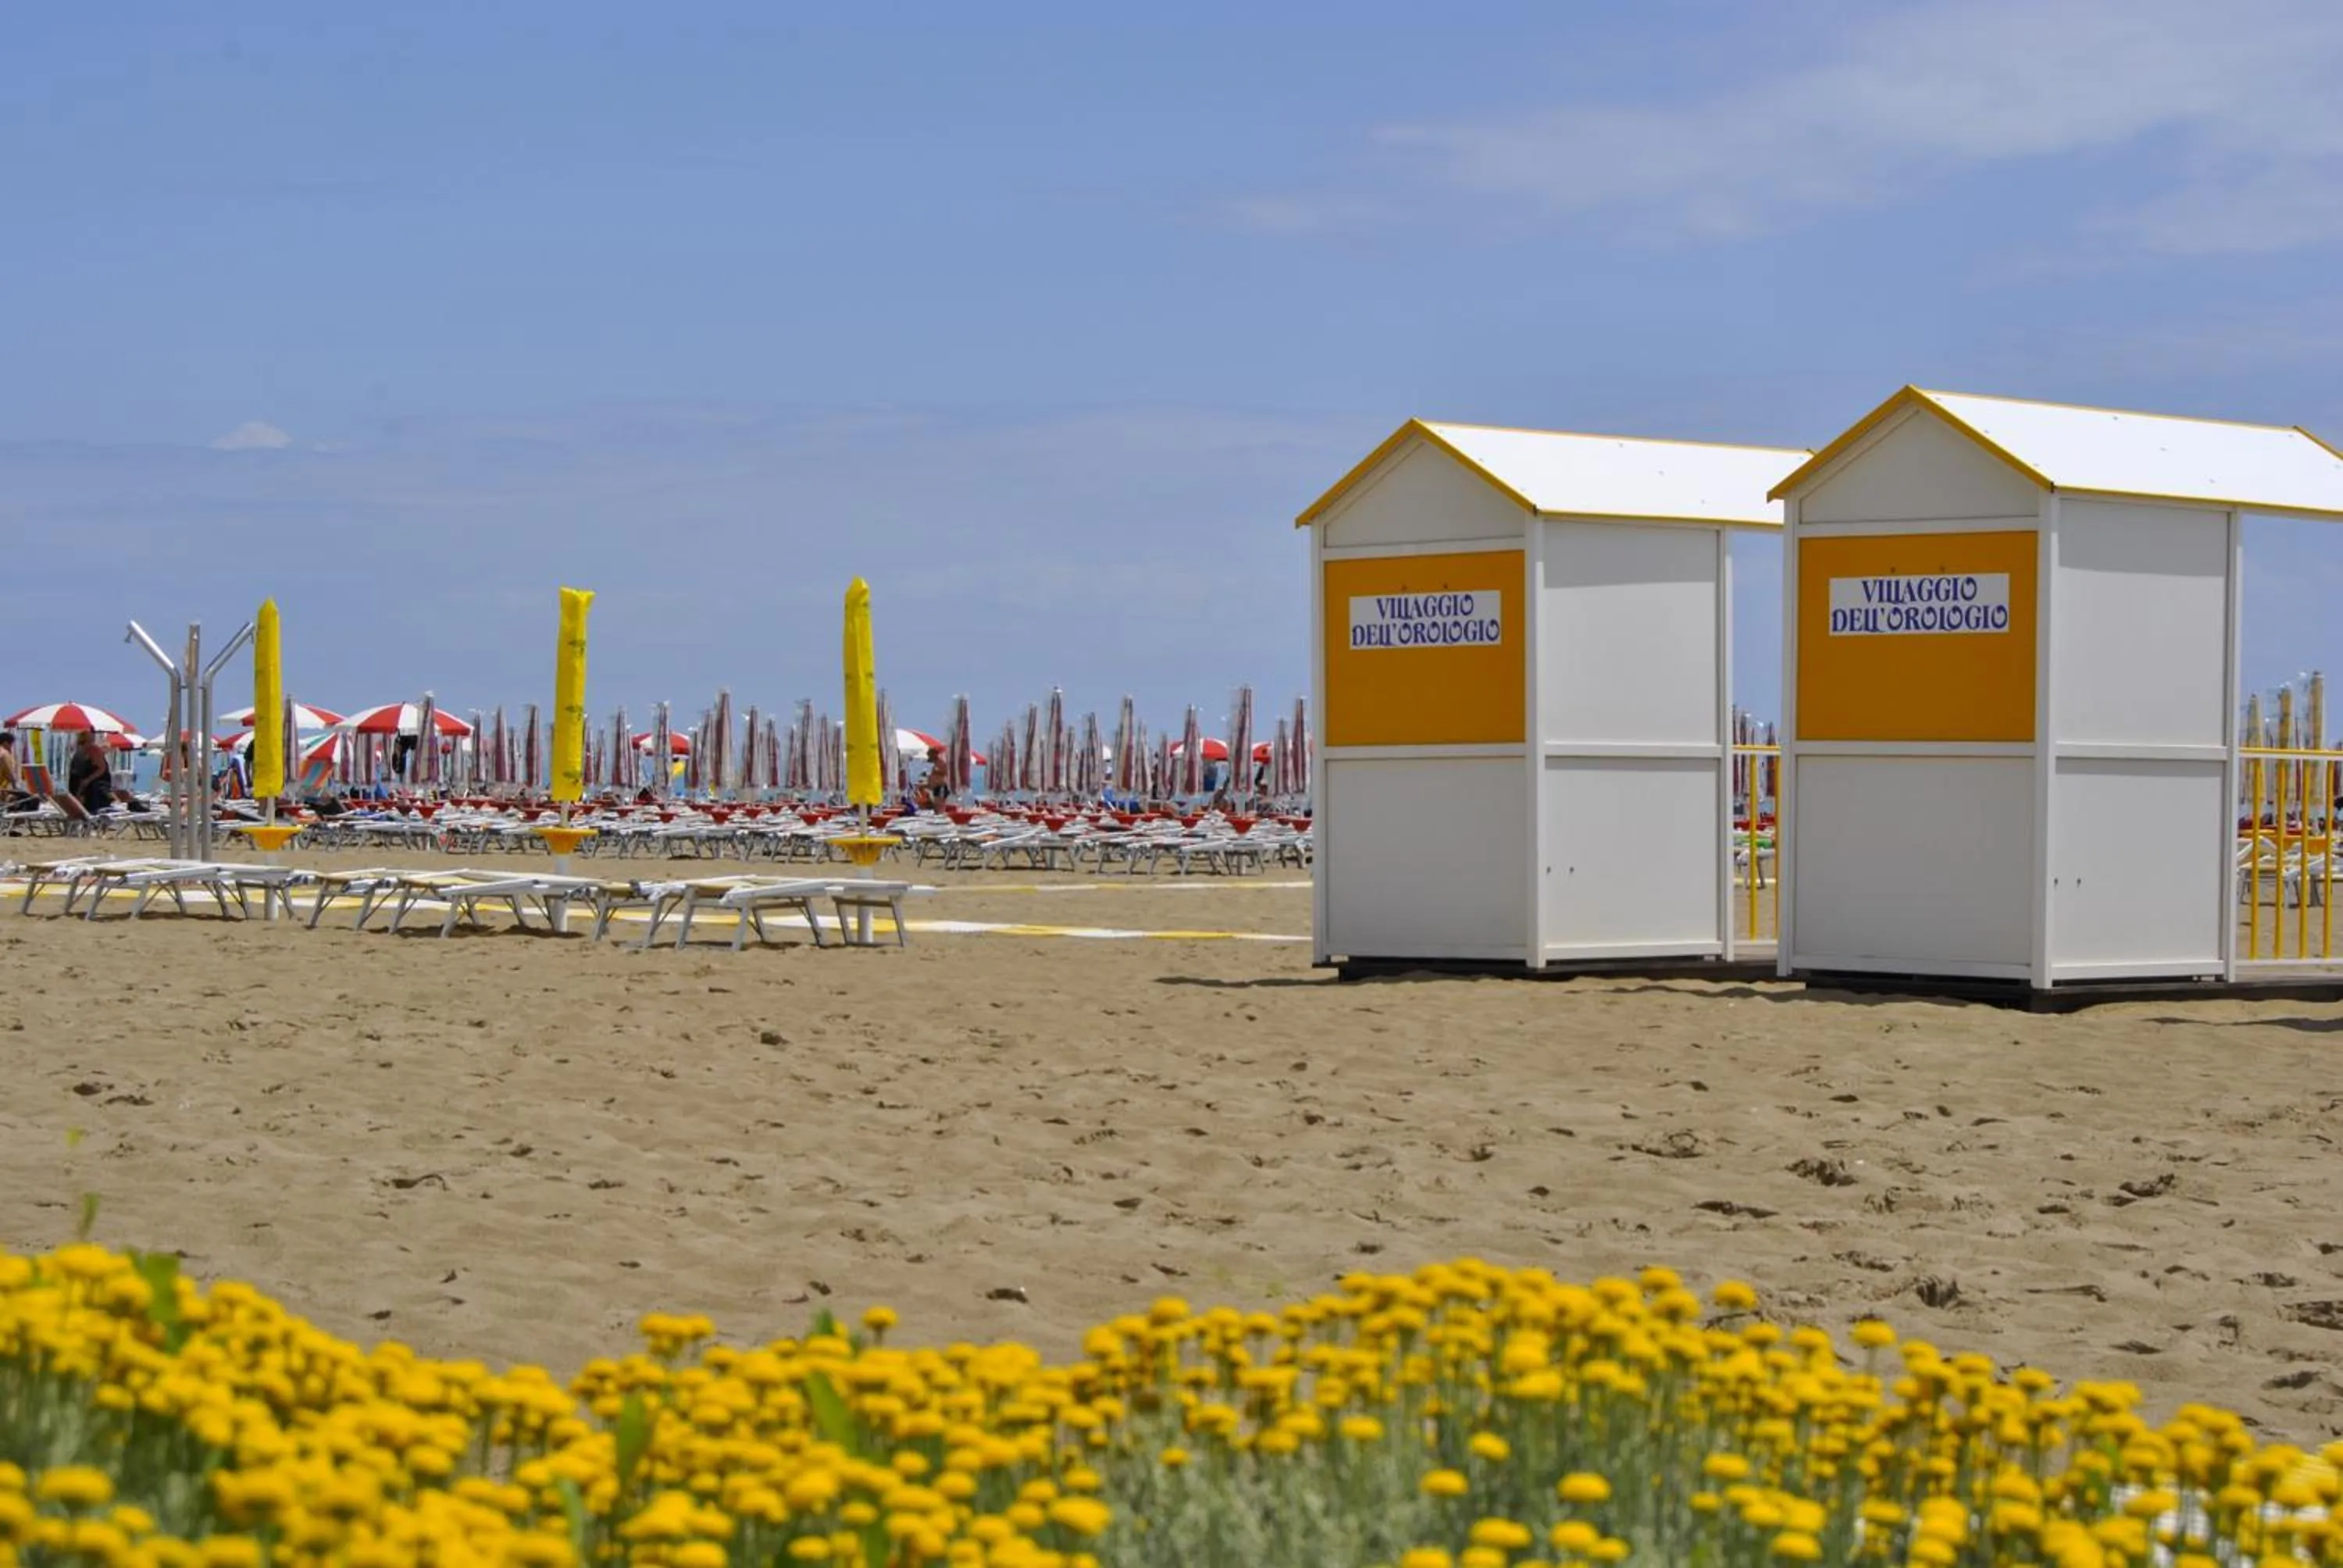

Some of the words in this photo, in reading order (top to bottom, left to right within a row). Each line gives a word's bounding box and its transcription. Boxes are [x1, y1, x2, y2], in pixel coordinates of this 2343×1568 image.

[1862, 576, 1977, 604] VILLAGGIO
[1376, 594, 1475, 619] VILLAGGIO
[1832, 604, 2008, 633] DELL'OROLOGIO
[1352, 619, 1500, 646] DELL'OROLOGIO
